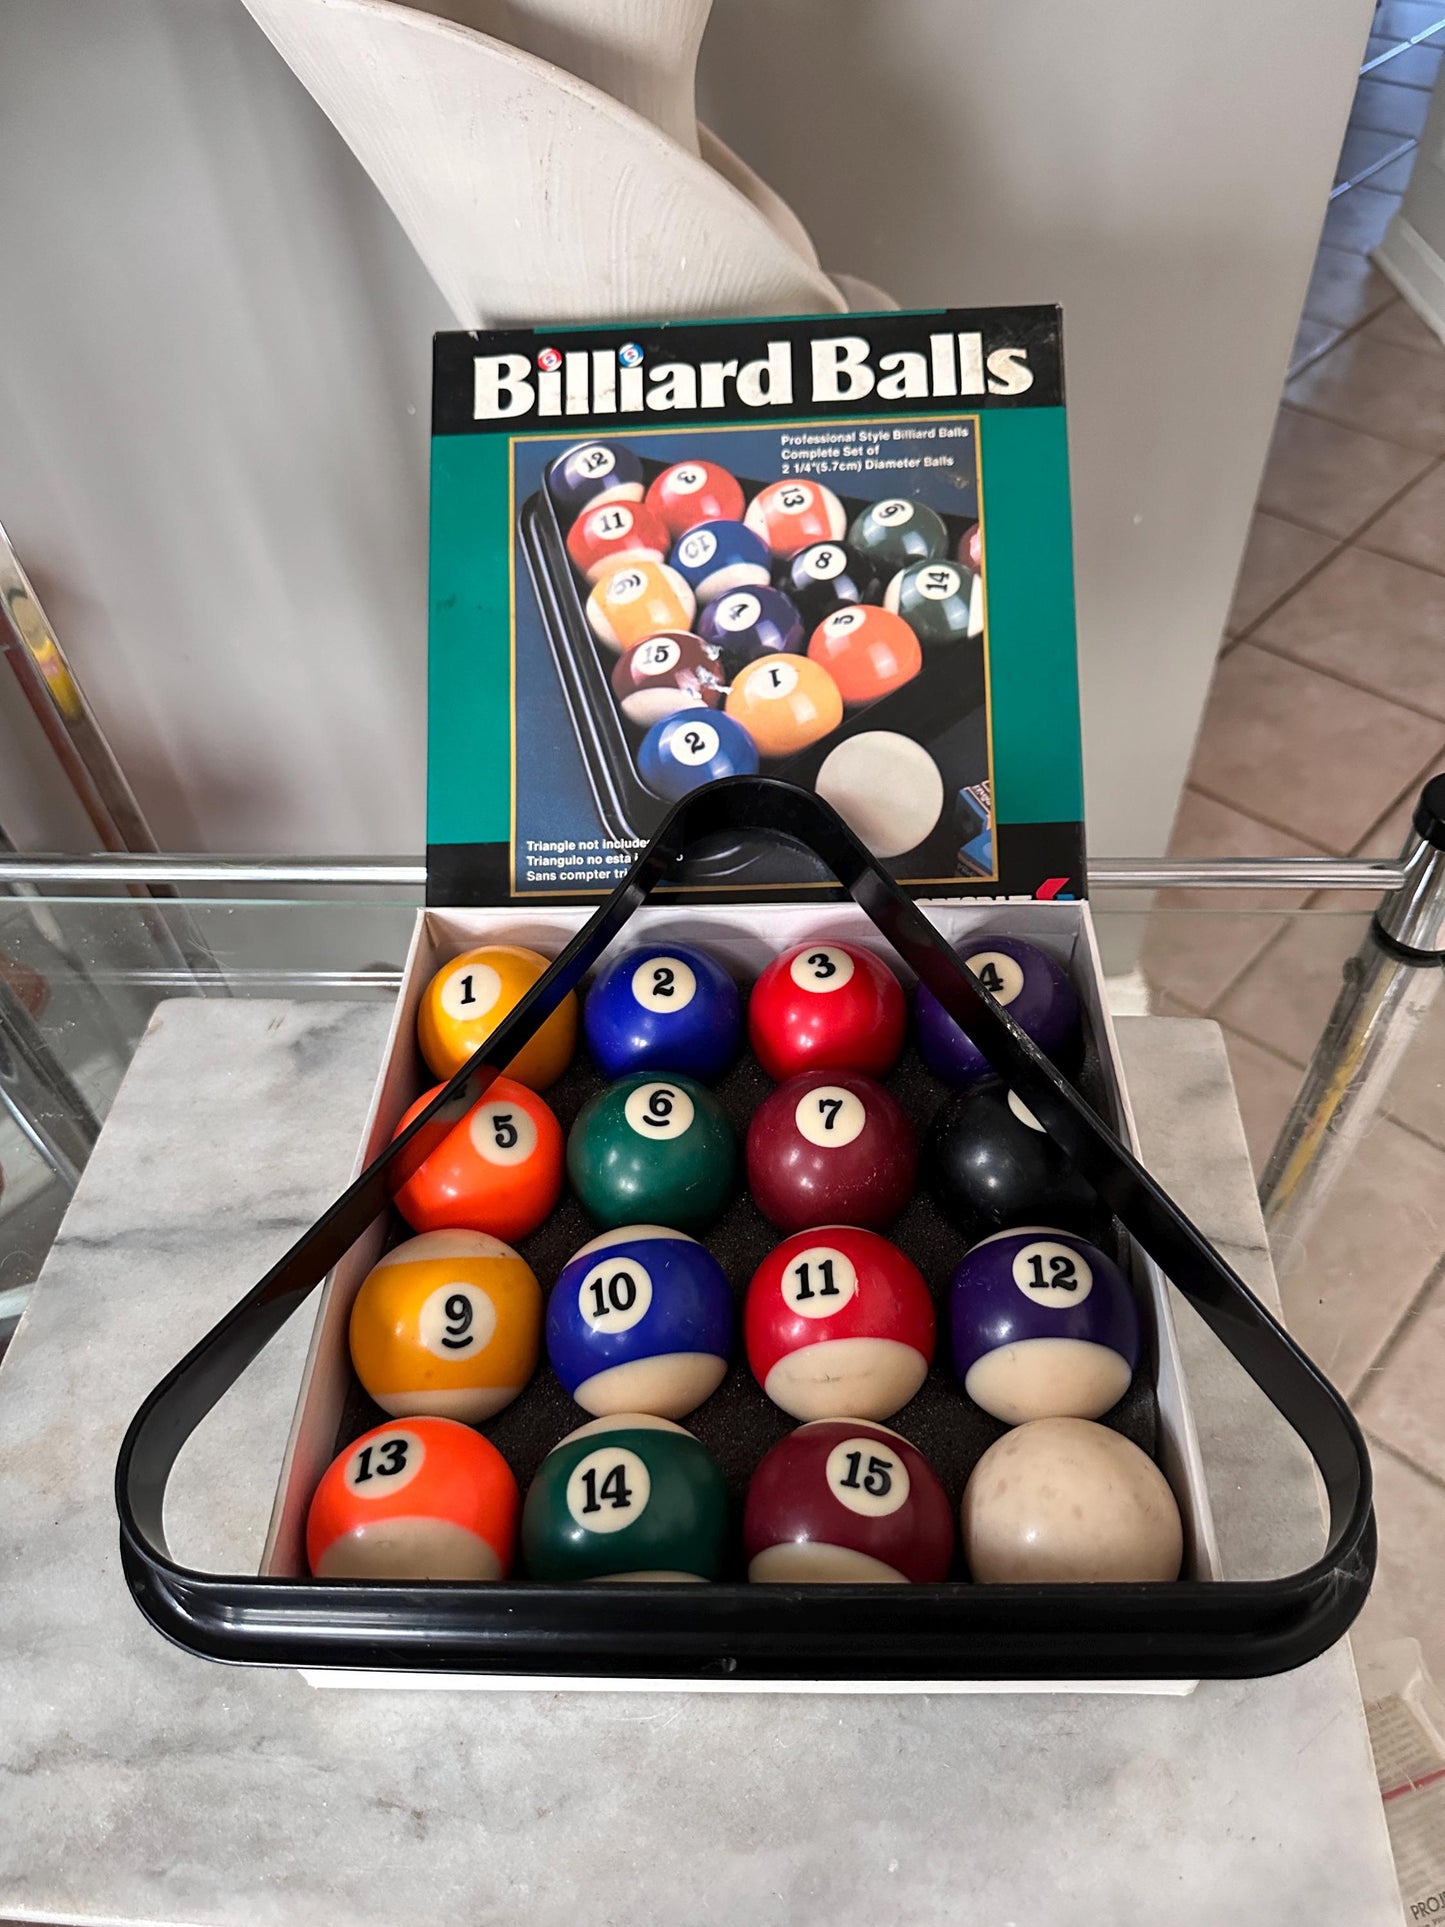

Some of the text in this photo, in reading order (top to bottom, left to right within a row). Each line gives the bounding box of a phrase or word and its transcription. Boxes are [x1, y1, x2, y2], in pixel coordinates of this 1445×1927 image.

[473, 331, 1034, 420] Billiard Balls
[780, 426, 970, 446] Professional Style Billiard Balls
[580, 451, 608, 474] 12
[780, 444, 880, 461] Complete Set of
[781, 464, 790, 475] 2
[864, 457, 922, 470] Diameter
[923, 455, 955, 467] Balls
[780, 487, 804, 509] 13
[600, 511, 625, 533] 11
[815, 551, 832, 570] 8
[926, 571, 950, 593] 14
[642, 645, 670, 666] 15
[684, 731, 706, 755] 2
[526, 839, 650, 853] Triangle not include
[526, 855, 585, 868] Triangulo
[586, 855, 603, 865] no
[604, 854, 632, 864] esta
[526, 870, 558, 882] Sans
[559, 869, 612, 884] compter
[807, 953, 836, 979] 3
[978, 962, 1004, 992] 4
[460, 975, 476, 1005] 1
[652, 967, 675, 997] 2
[642, 1089, 676, 1127] 6
[818, 1098, 843, 1130] 7
[492, 1114, 518, 1148] 5
[794, 1259, 840, 1301] 11
[1026, 1254, 1078, 1292] 12
[589, 1271, 637, 1318] 10
[440, 1294, 474, 1349] 9
[354, 1438, 410, 1484] 13
[839, 1451, 893, 1497] 15
[581, 1464, 632, 1514] 14
